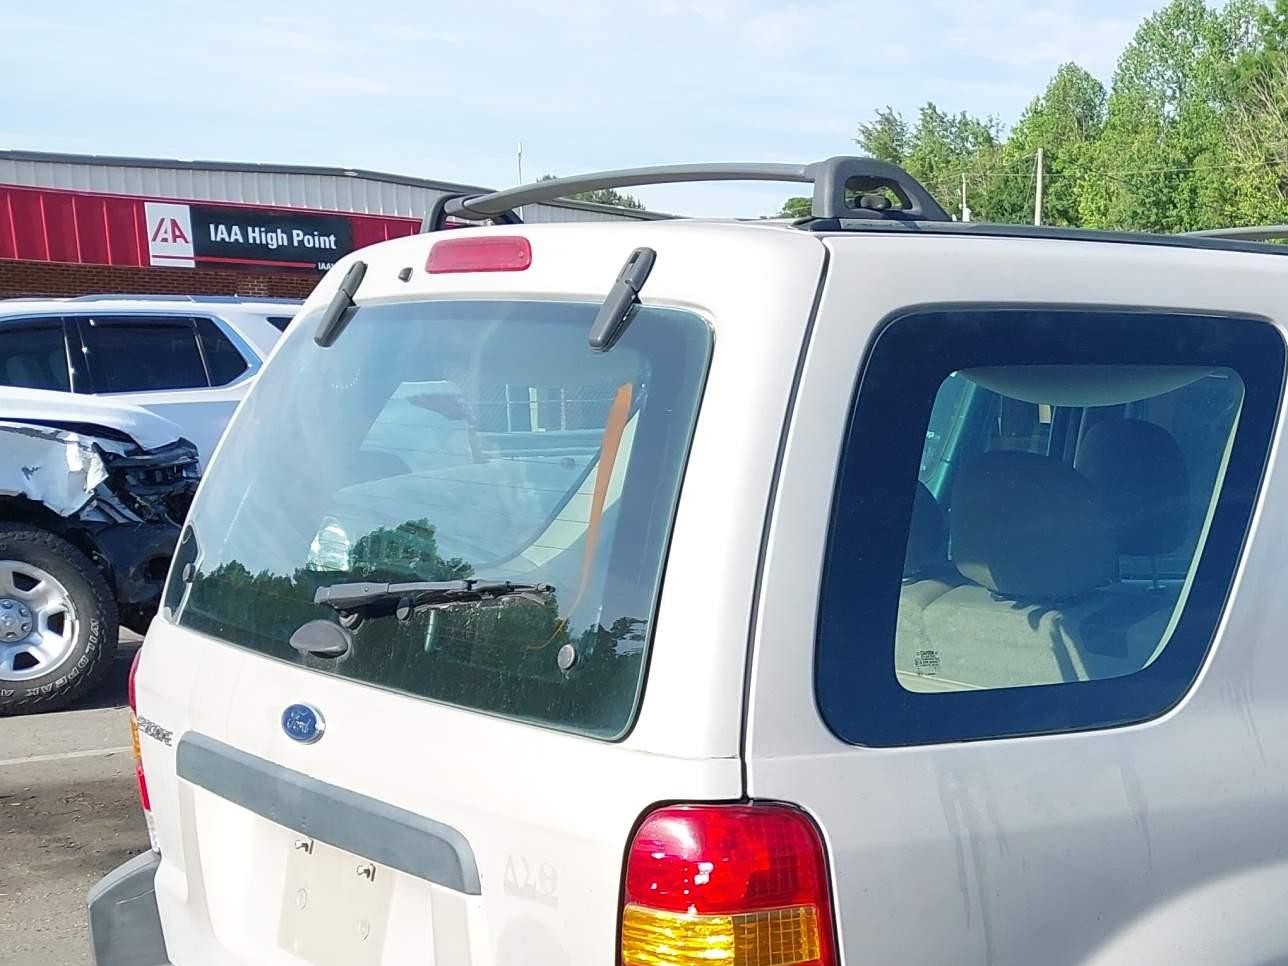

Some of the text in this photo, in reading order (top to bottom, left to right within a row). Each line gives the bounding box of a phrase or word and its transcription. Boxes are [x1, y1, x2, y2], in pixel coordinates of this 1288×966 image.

[209, 223, 336, 249] IAA High Point
